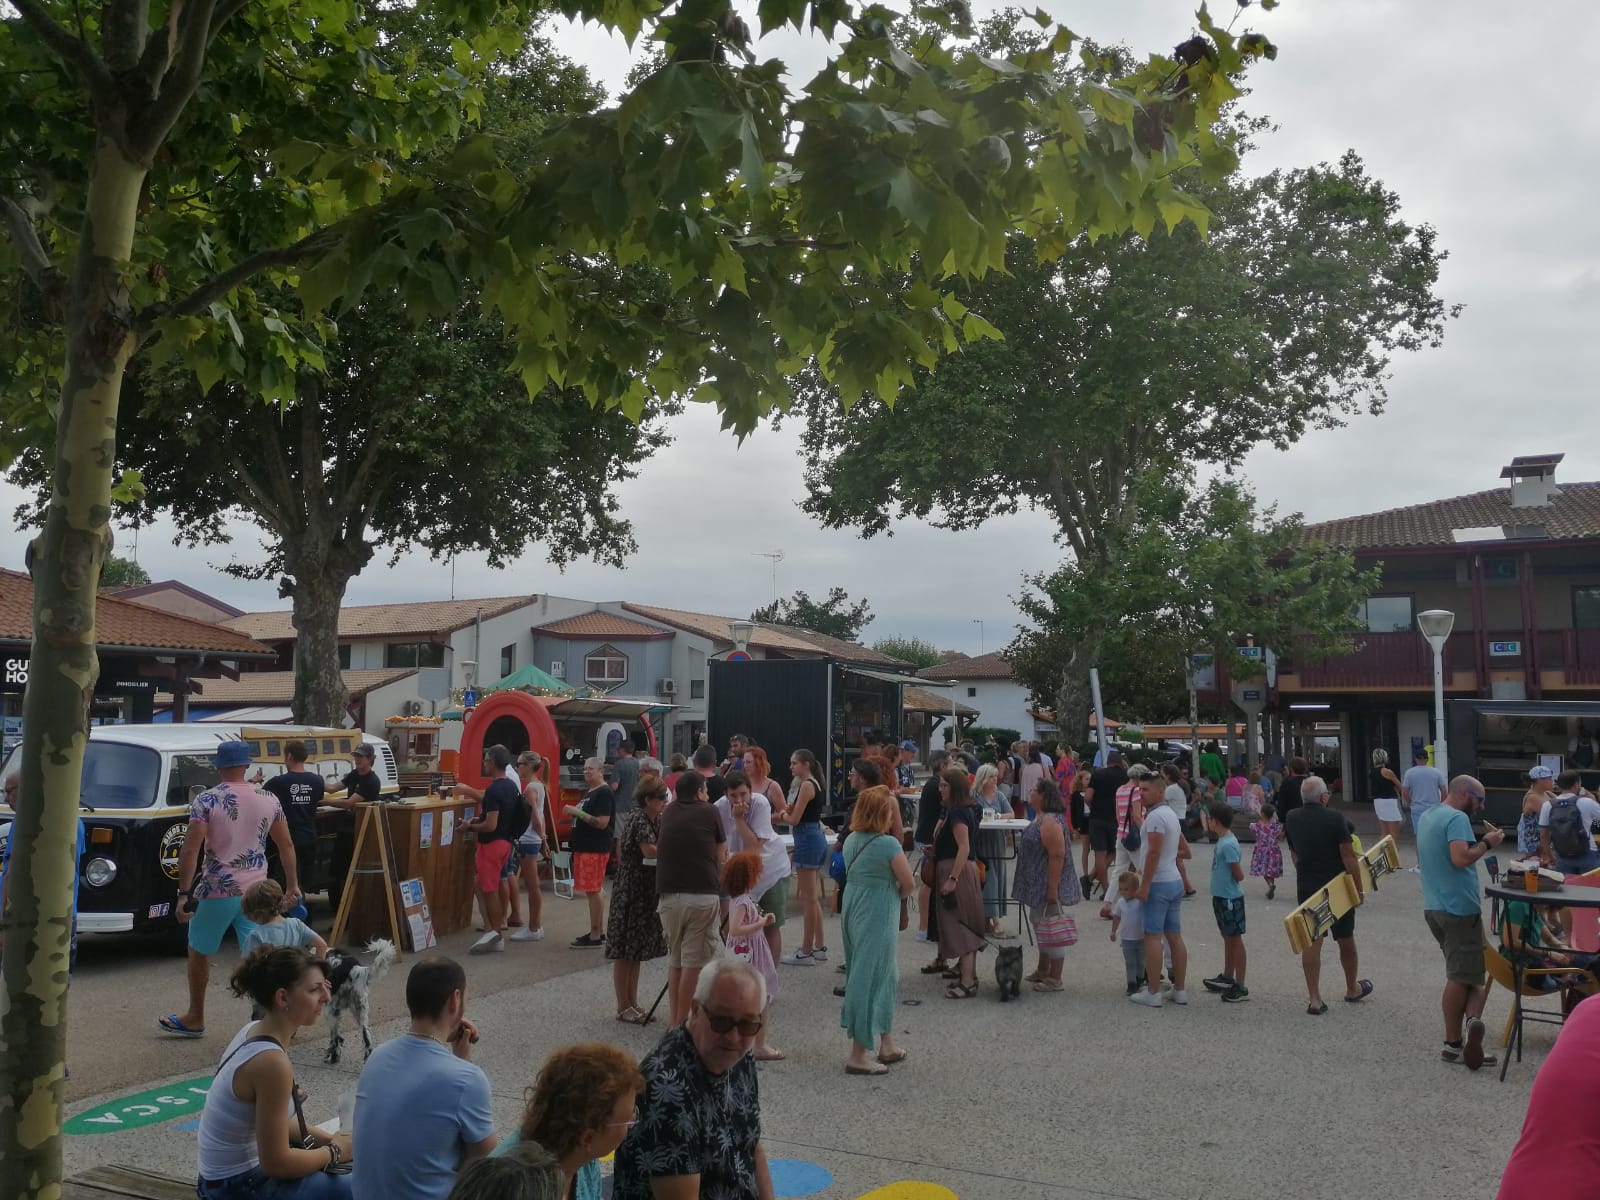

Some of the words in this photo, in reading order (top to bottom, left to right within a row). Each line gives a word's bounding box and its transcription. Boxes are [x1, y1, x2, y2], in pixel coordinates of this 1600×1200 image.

[5, 659, 30, 671] GU
[5, 671, 29, 684] HO
[116, 680, 149, 688] IMMOBILIER
[290, 794, 311, 802] Team
[83, 1087, 210, 1124] ISCA
